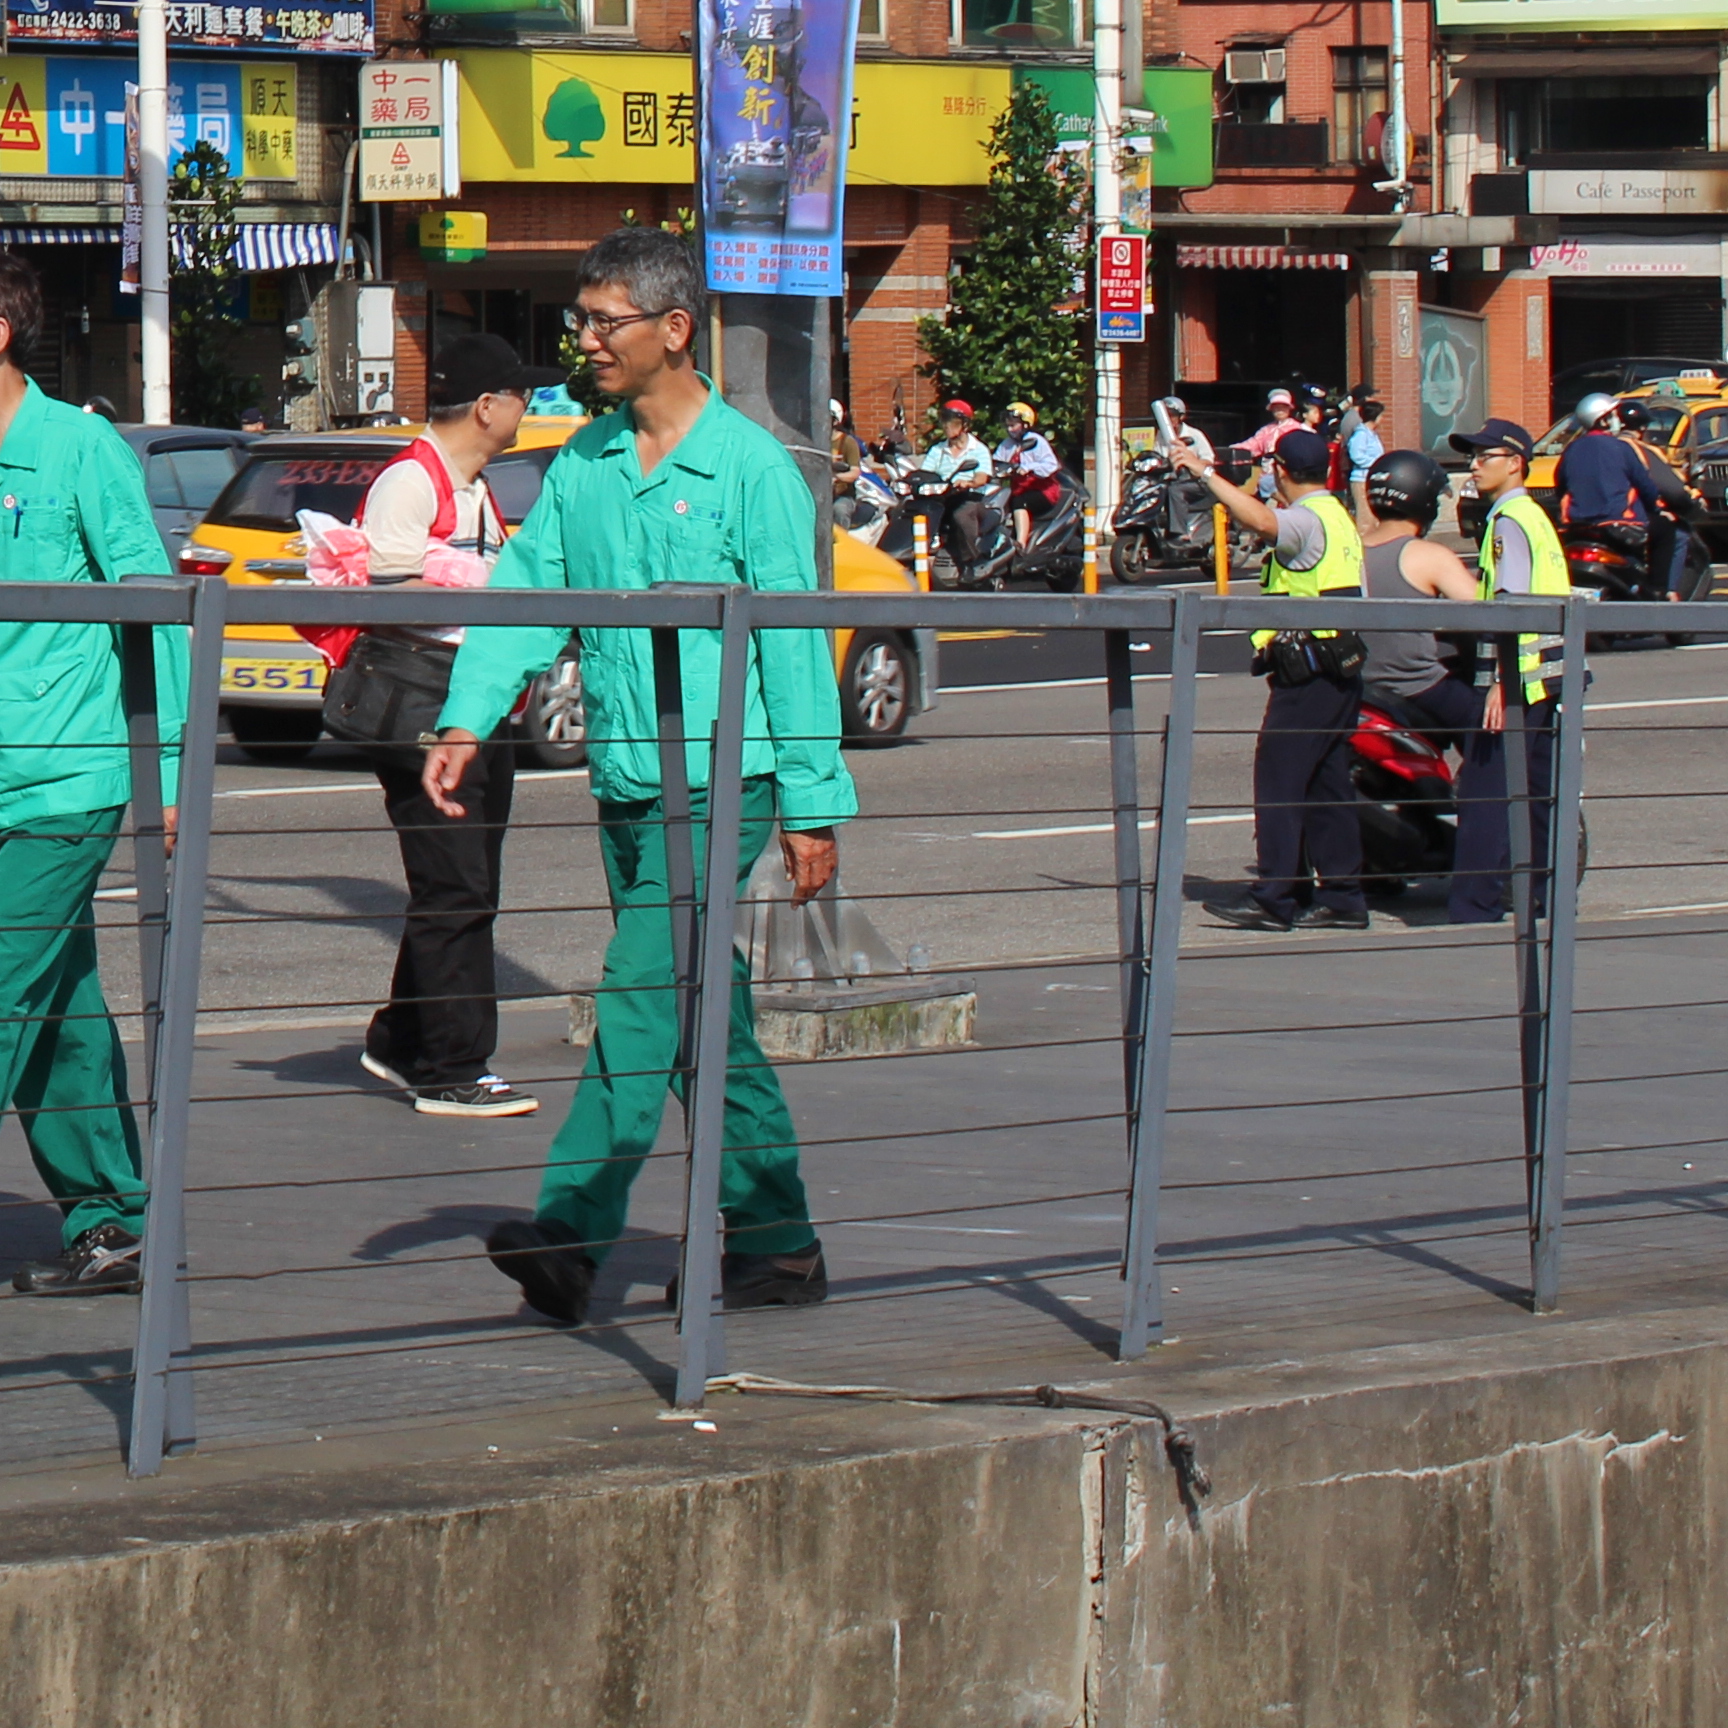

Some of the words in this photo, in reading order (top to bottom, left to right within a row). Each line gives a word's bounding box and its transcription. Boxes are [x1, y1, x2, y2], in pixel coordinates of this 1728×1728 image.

[332, 11, 365, 41] 咖啡
[372, 69, 431, 93] 中一
[249, 77, 289, 117] 順天
[942, 95, 987, 117] 基隆分行
[371, 97, 431, 123] 藥局
[246, 129, 293, 161] 科學中藥
[366, 171, 439, 192] 順天科學中藥
[1576, 181, 1613, 200] Café
[1621, 181, 1696, 204] Passeport
[232, 666, 324, 690] 551
